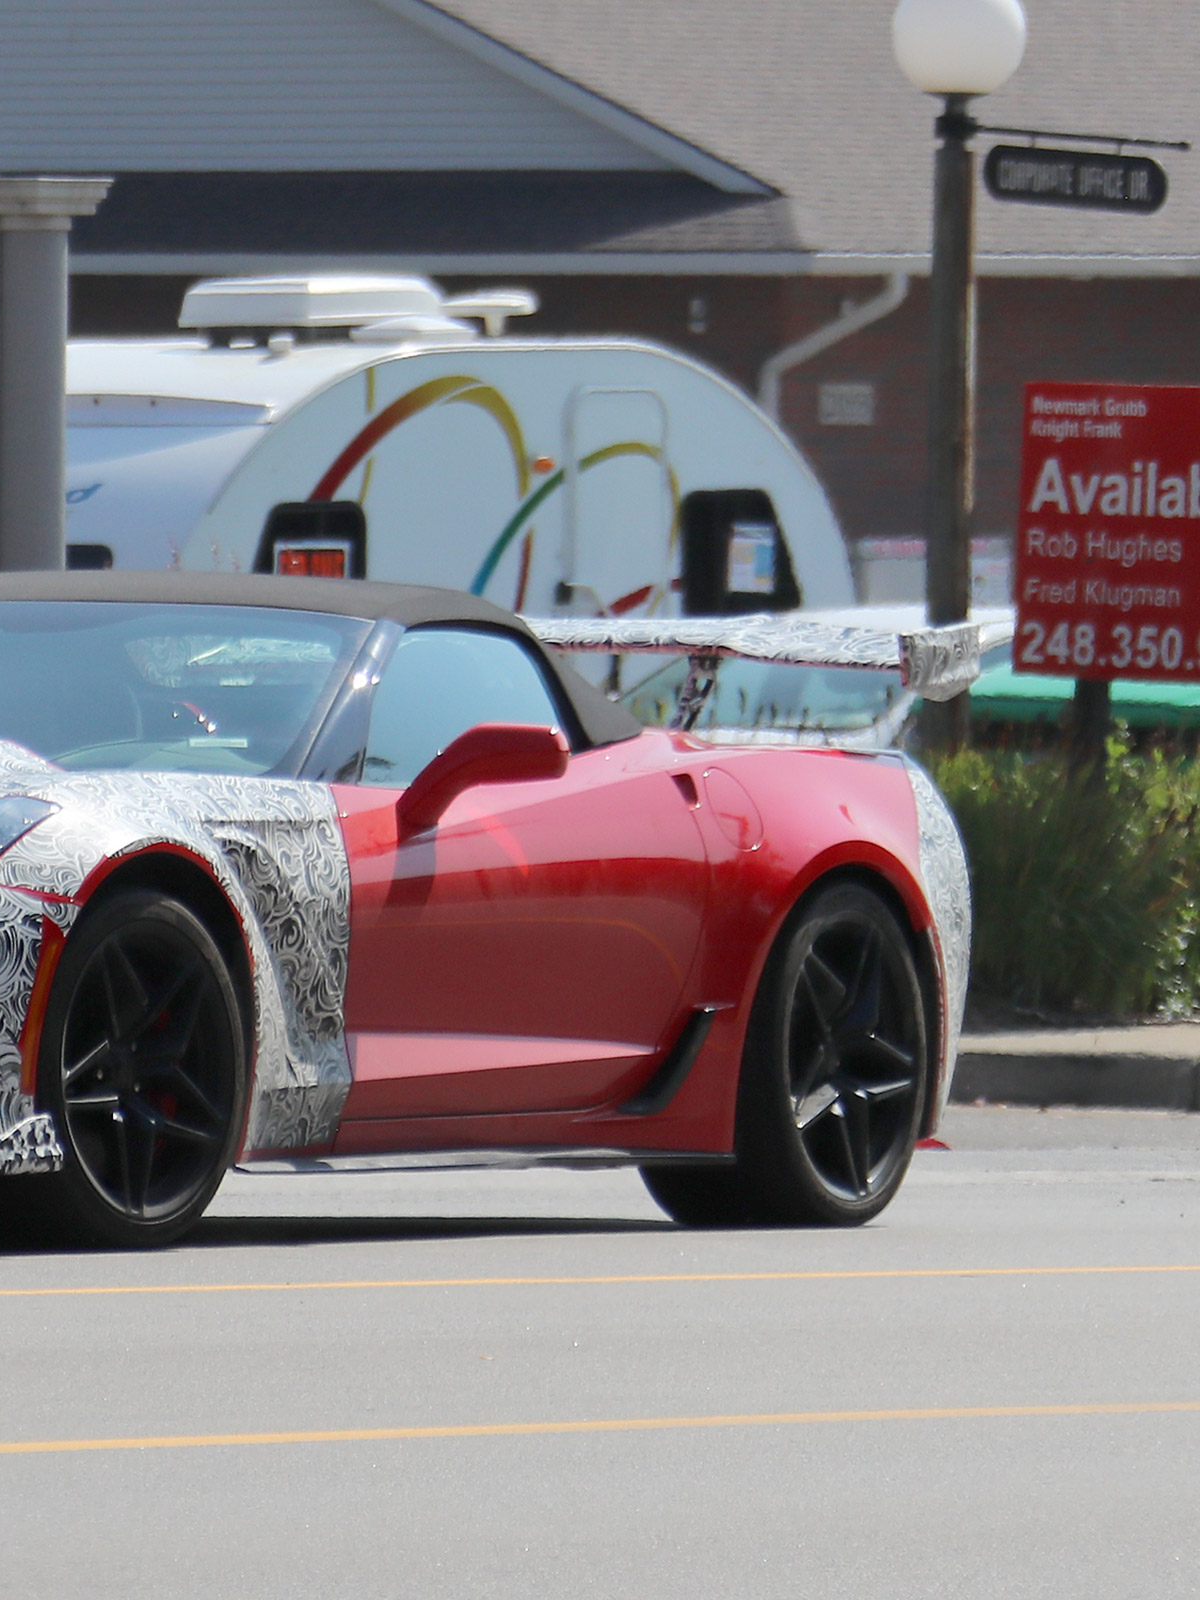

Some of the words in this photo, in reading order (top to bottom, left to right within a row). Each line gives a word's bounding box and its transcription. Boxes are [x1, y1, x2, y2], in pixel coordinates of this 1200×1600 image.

[1032, 396, 1100, 417] Newmark
[1104, 397, 1147, 417] Grubb
[1030, 419, 1079, 442] Knight
[1083, 419, 1122, 439] Frank
[1025, 528, 1078, 558] Rob
[1085, 531, 1182, 568] Hughes
[1023, 578, 1076, 604] Fred
[1085, 580, 1181, 612] Klugman
